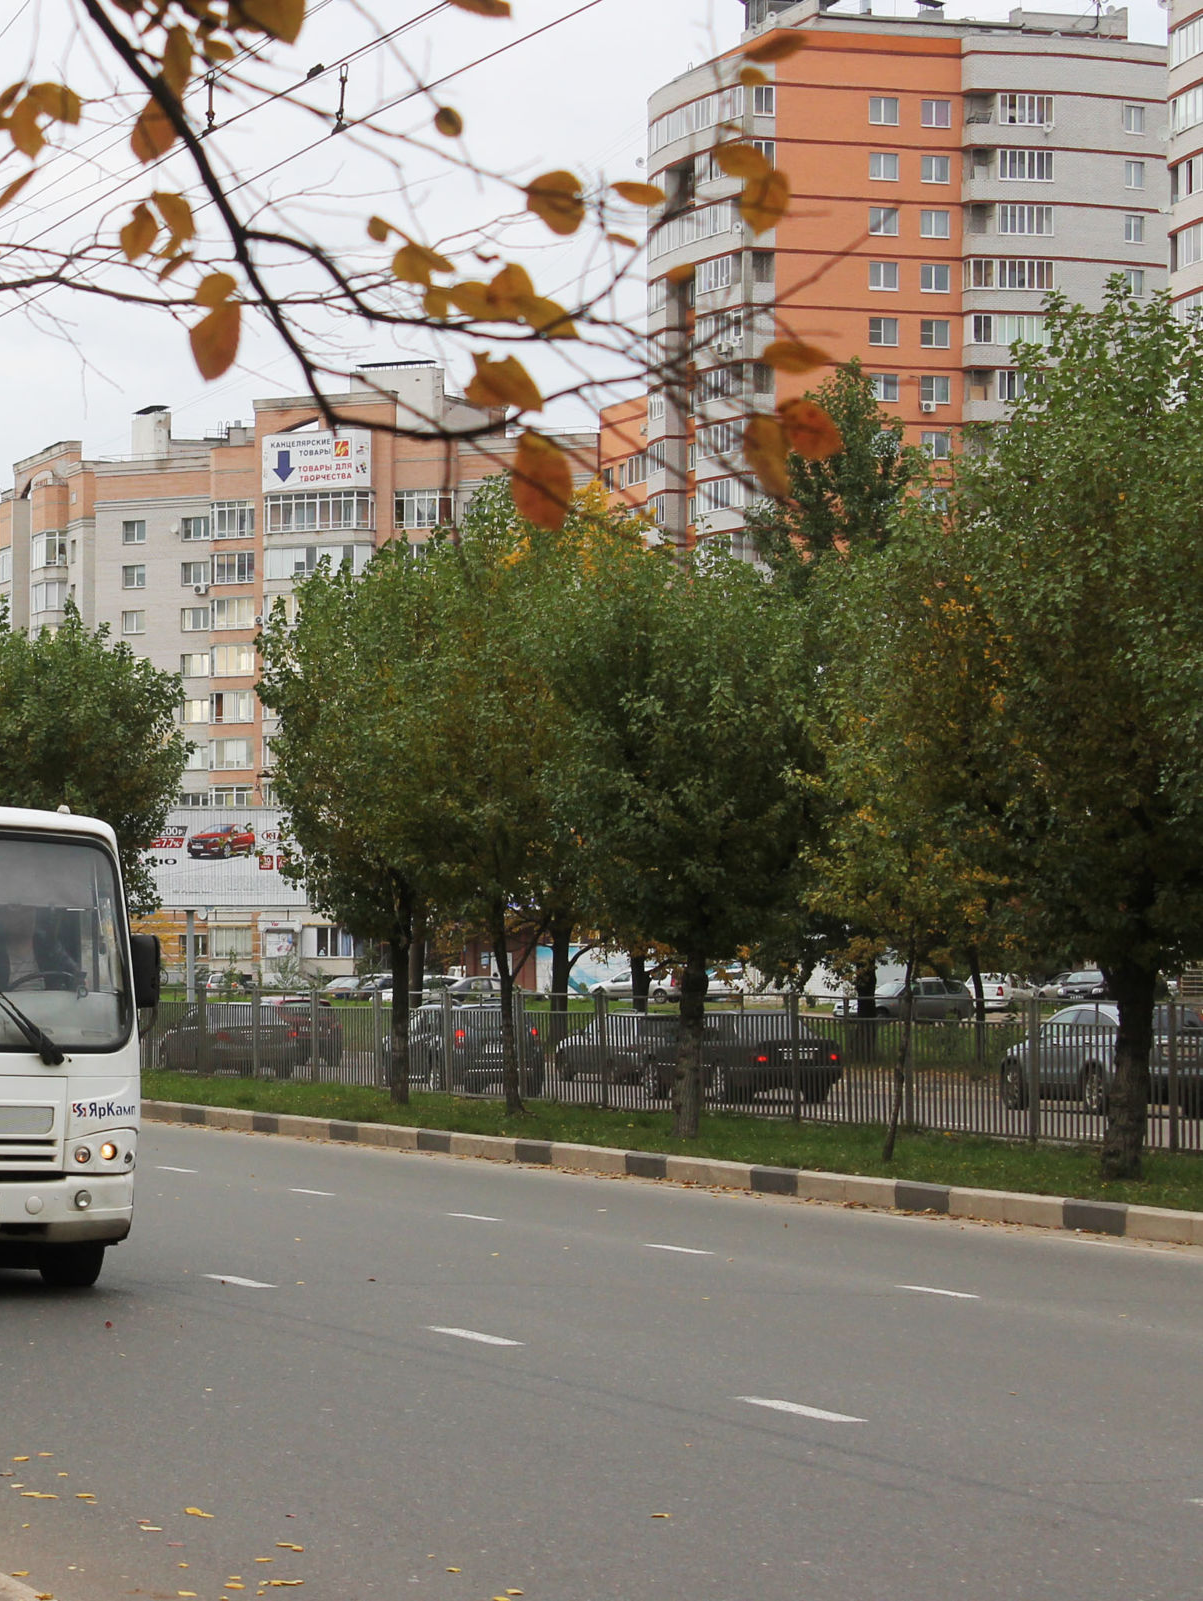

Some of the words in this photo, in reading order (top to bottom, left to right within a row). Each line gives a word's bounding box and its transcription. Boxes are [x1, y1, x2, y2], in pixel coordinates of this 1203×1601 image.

[270, 438, 331, 449] КАНЦЕЛЯРСКИЕ
[299, 449, 332, 457] ТОВАРЫ
[298, 464, 332, 472] ТОВАРЫ
[335, 462, 352, 471] ДЛЯ
[300, 472, 352, 482] ТВОРЧЕСТВА
[89, 1102, 136, 1119] ЯрКамп
